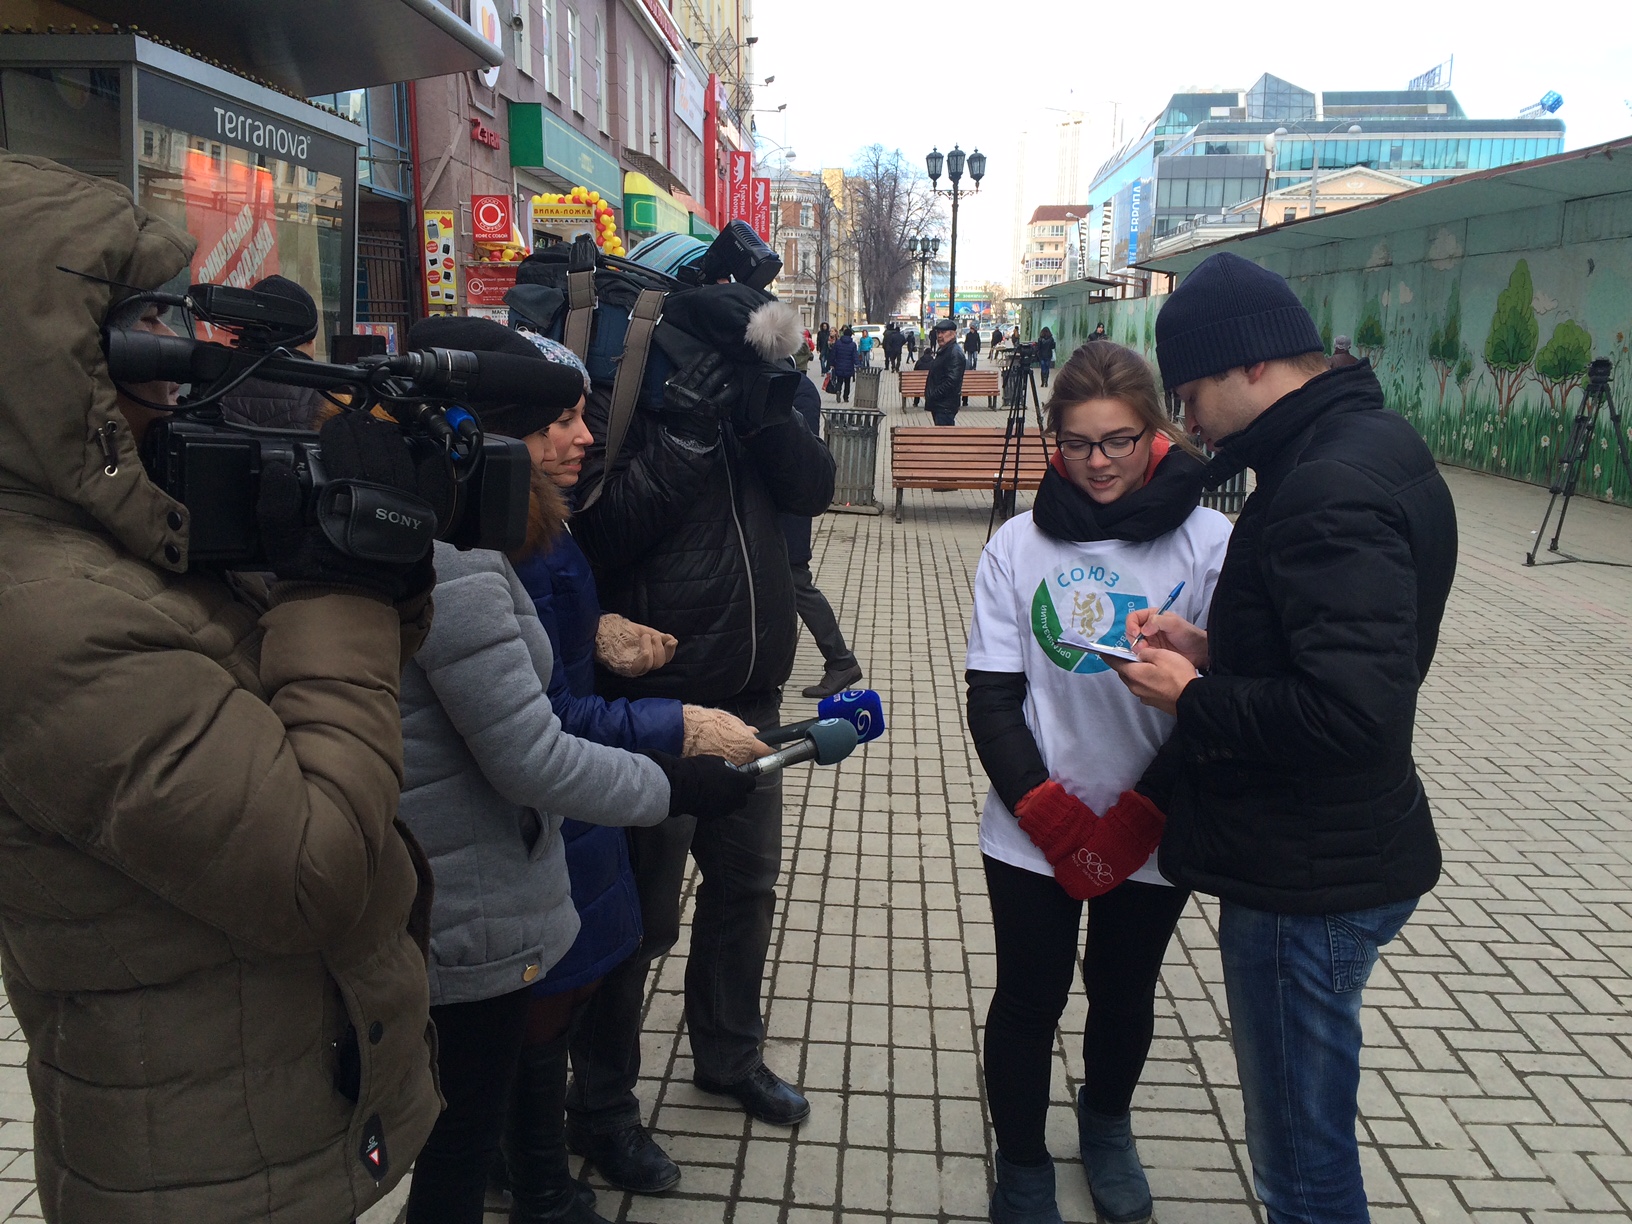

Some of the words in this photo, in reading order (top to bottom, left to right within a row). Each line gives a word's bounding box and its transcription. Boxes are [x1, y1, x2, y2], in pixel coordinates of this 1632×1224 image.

[198, 203, 254, 284] ФИНАЛЬНАЯ
[375, 508, 422, 530] SONY
[1057, 565, 1120, 588] СОЮЗ
